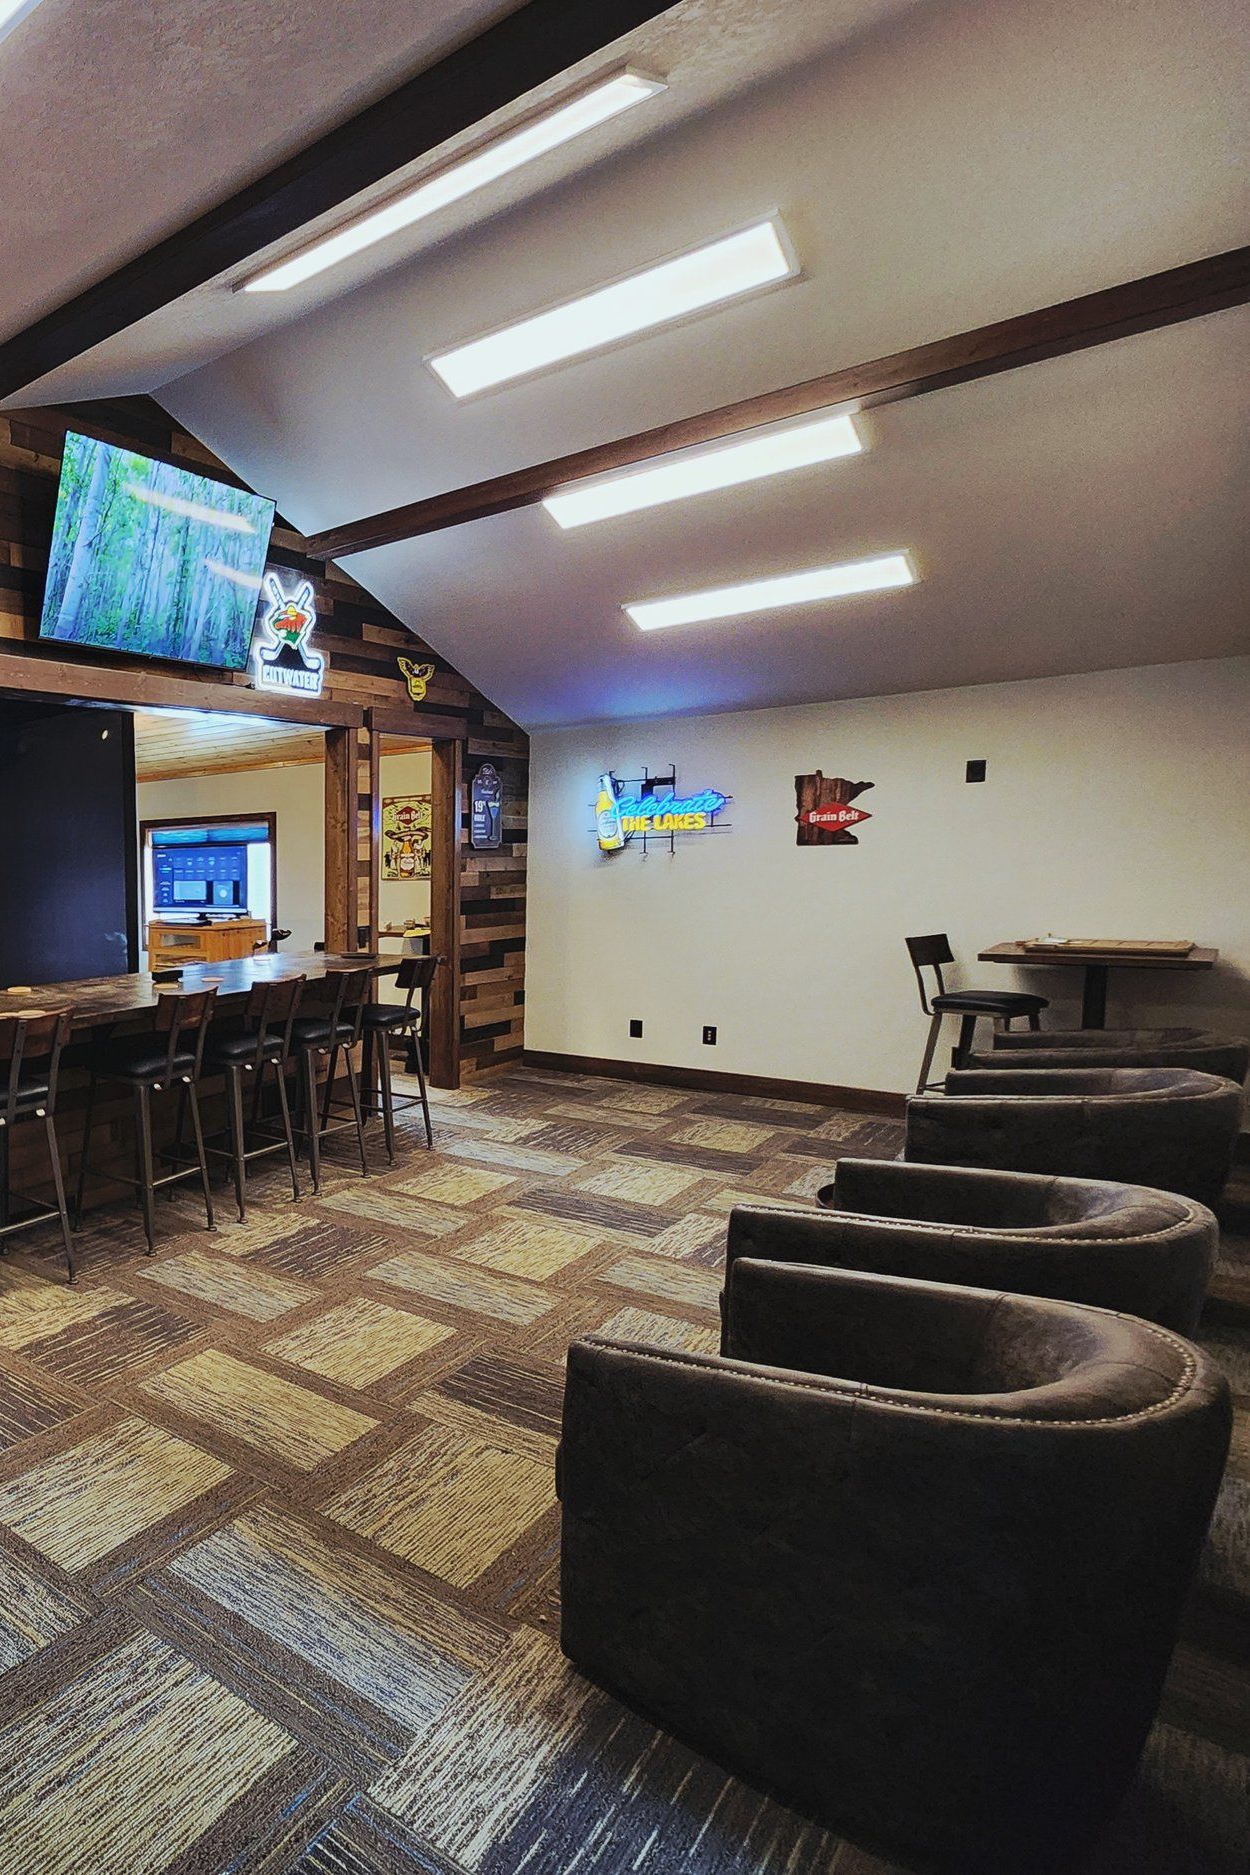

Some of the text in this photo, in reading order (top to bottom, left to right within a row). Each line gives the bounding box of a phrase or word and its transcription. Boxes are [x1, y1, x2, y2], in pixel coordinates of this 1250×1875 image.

[262, 664, 320, 690] CUTWATER
[611, 789, 725, 818] Celebrate
[621, 812, 707, 832] THE LAKES
[809, 810, 860, 824] Grain Belt
